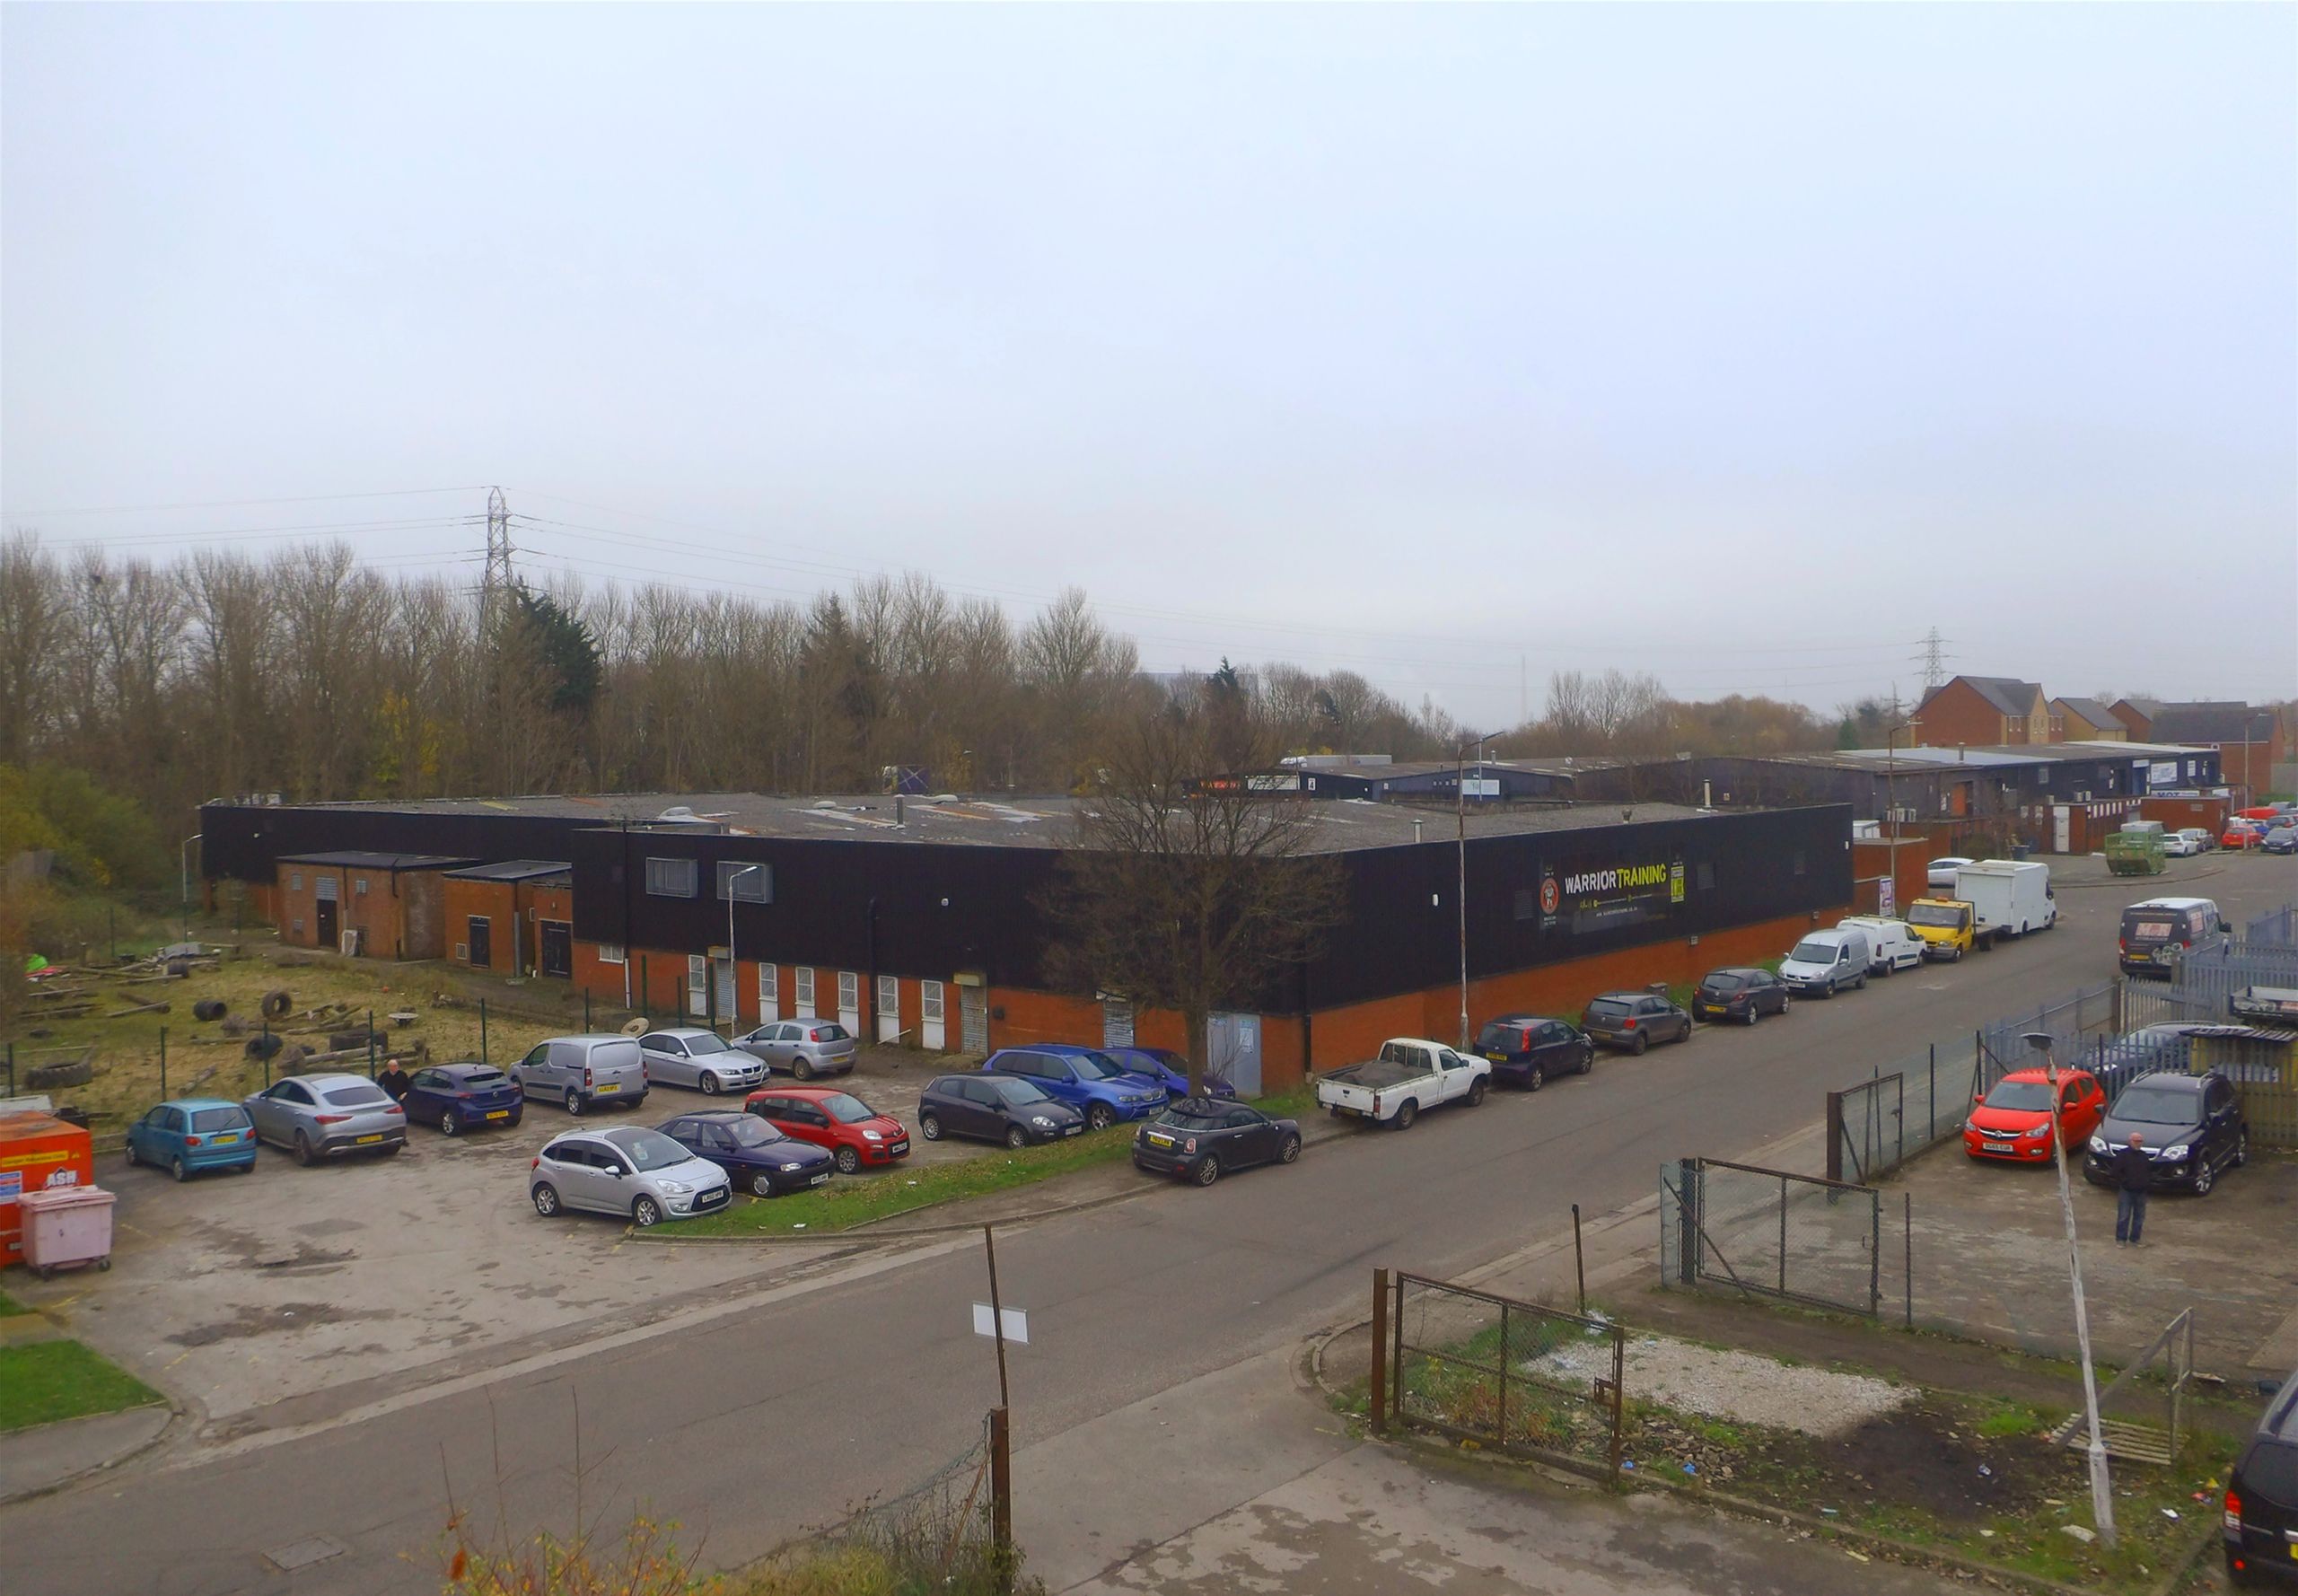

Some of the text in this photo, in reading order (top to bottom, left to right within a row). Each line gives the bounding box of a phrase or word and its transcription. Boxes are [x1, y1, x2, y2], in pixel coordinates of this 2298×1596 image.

[1565, 870, 1616, 894] WARRIOR
[1617, 864, 1667, 889] TRAINING
[47, 1171, 77, 1187] ASH
